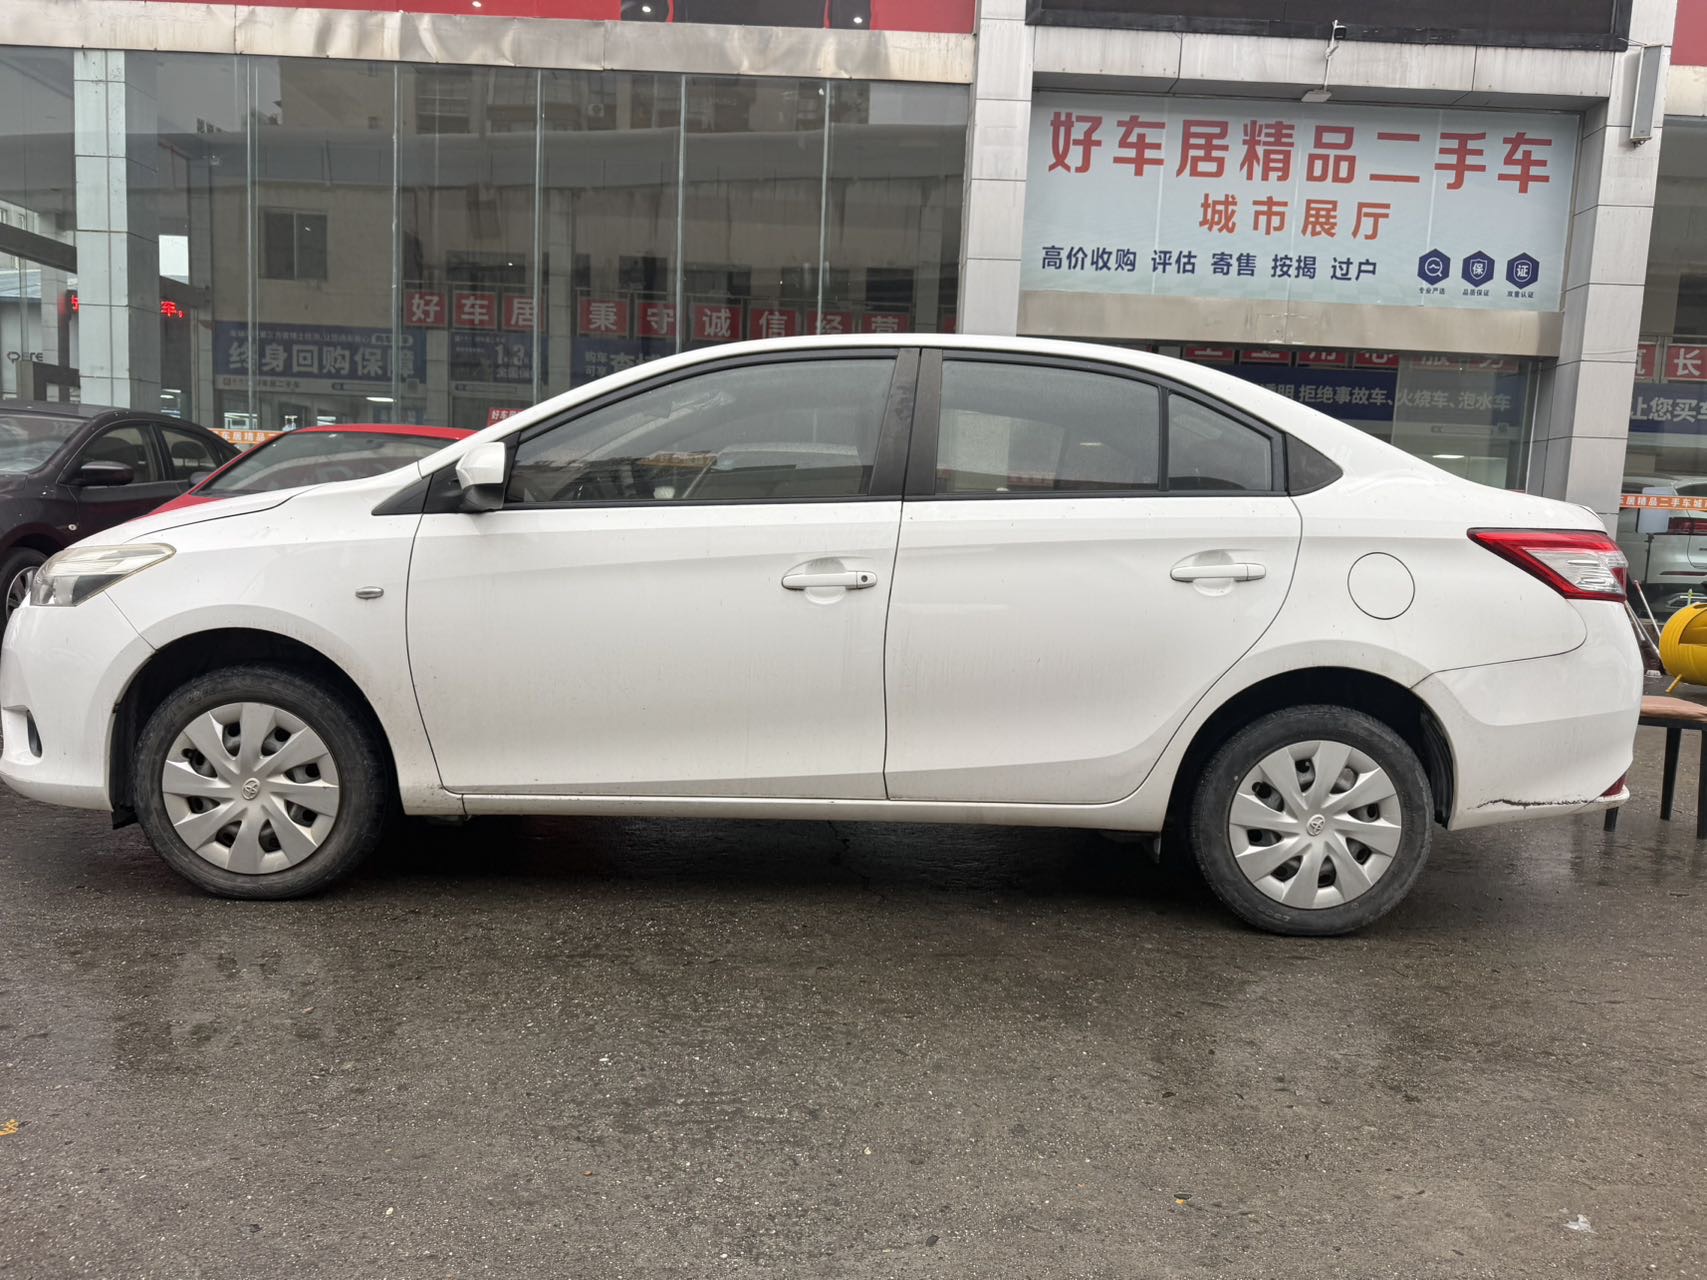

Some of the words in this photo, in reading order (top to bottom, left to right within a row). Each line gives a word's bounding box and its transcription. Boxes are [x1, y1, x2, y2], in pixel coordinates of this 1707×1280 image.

[1048, 110, 1553, 194] 好车居精品二手车
[1199, 193, 1391, 240] 城市展厅
[1041, 245, 1137, 273] 高价收购
[1151, 249, 1198, 275] 评估
[1210, 251, 1257, 277] 寄售
[1271, 253, 1317, 280] 按揭
[1330, 257, 1377, 281] 过户
[1473, 263, 1483, 274] 保
[1517, 265, 1528, 277] 证
[411, 293, 537, 327] 好车居
[1462, 289, 1489, 297] 品质保证
[229, 342, 415, 377] 终身回购保障
